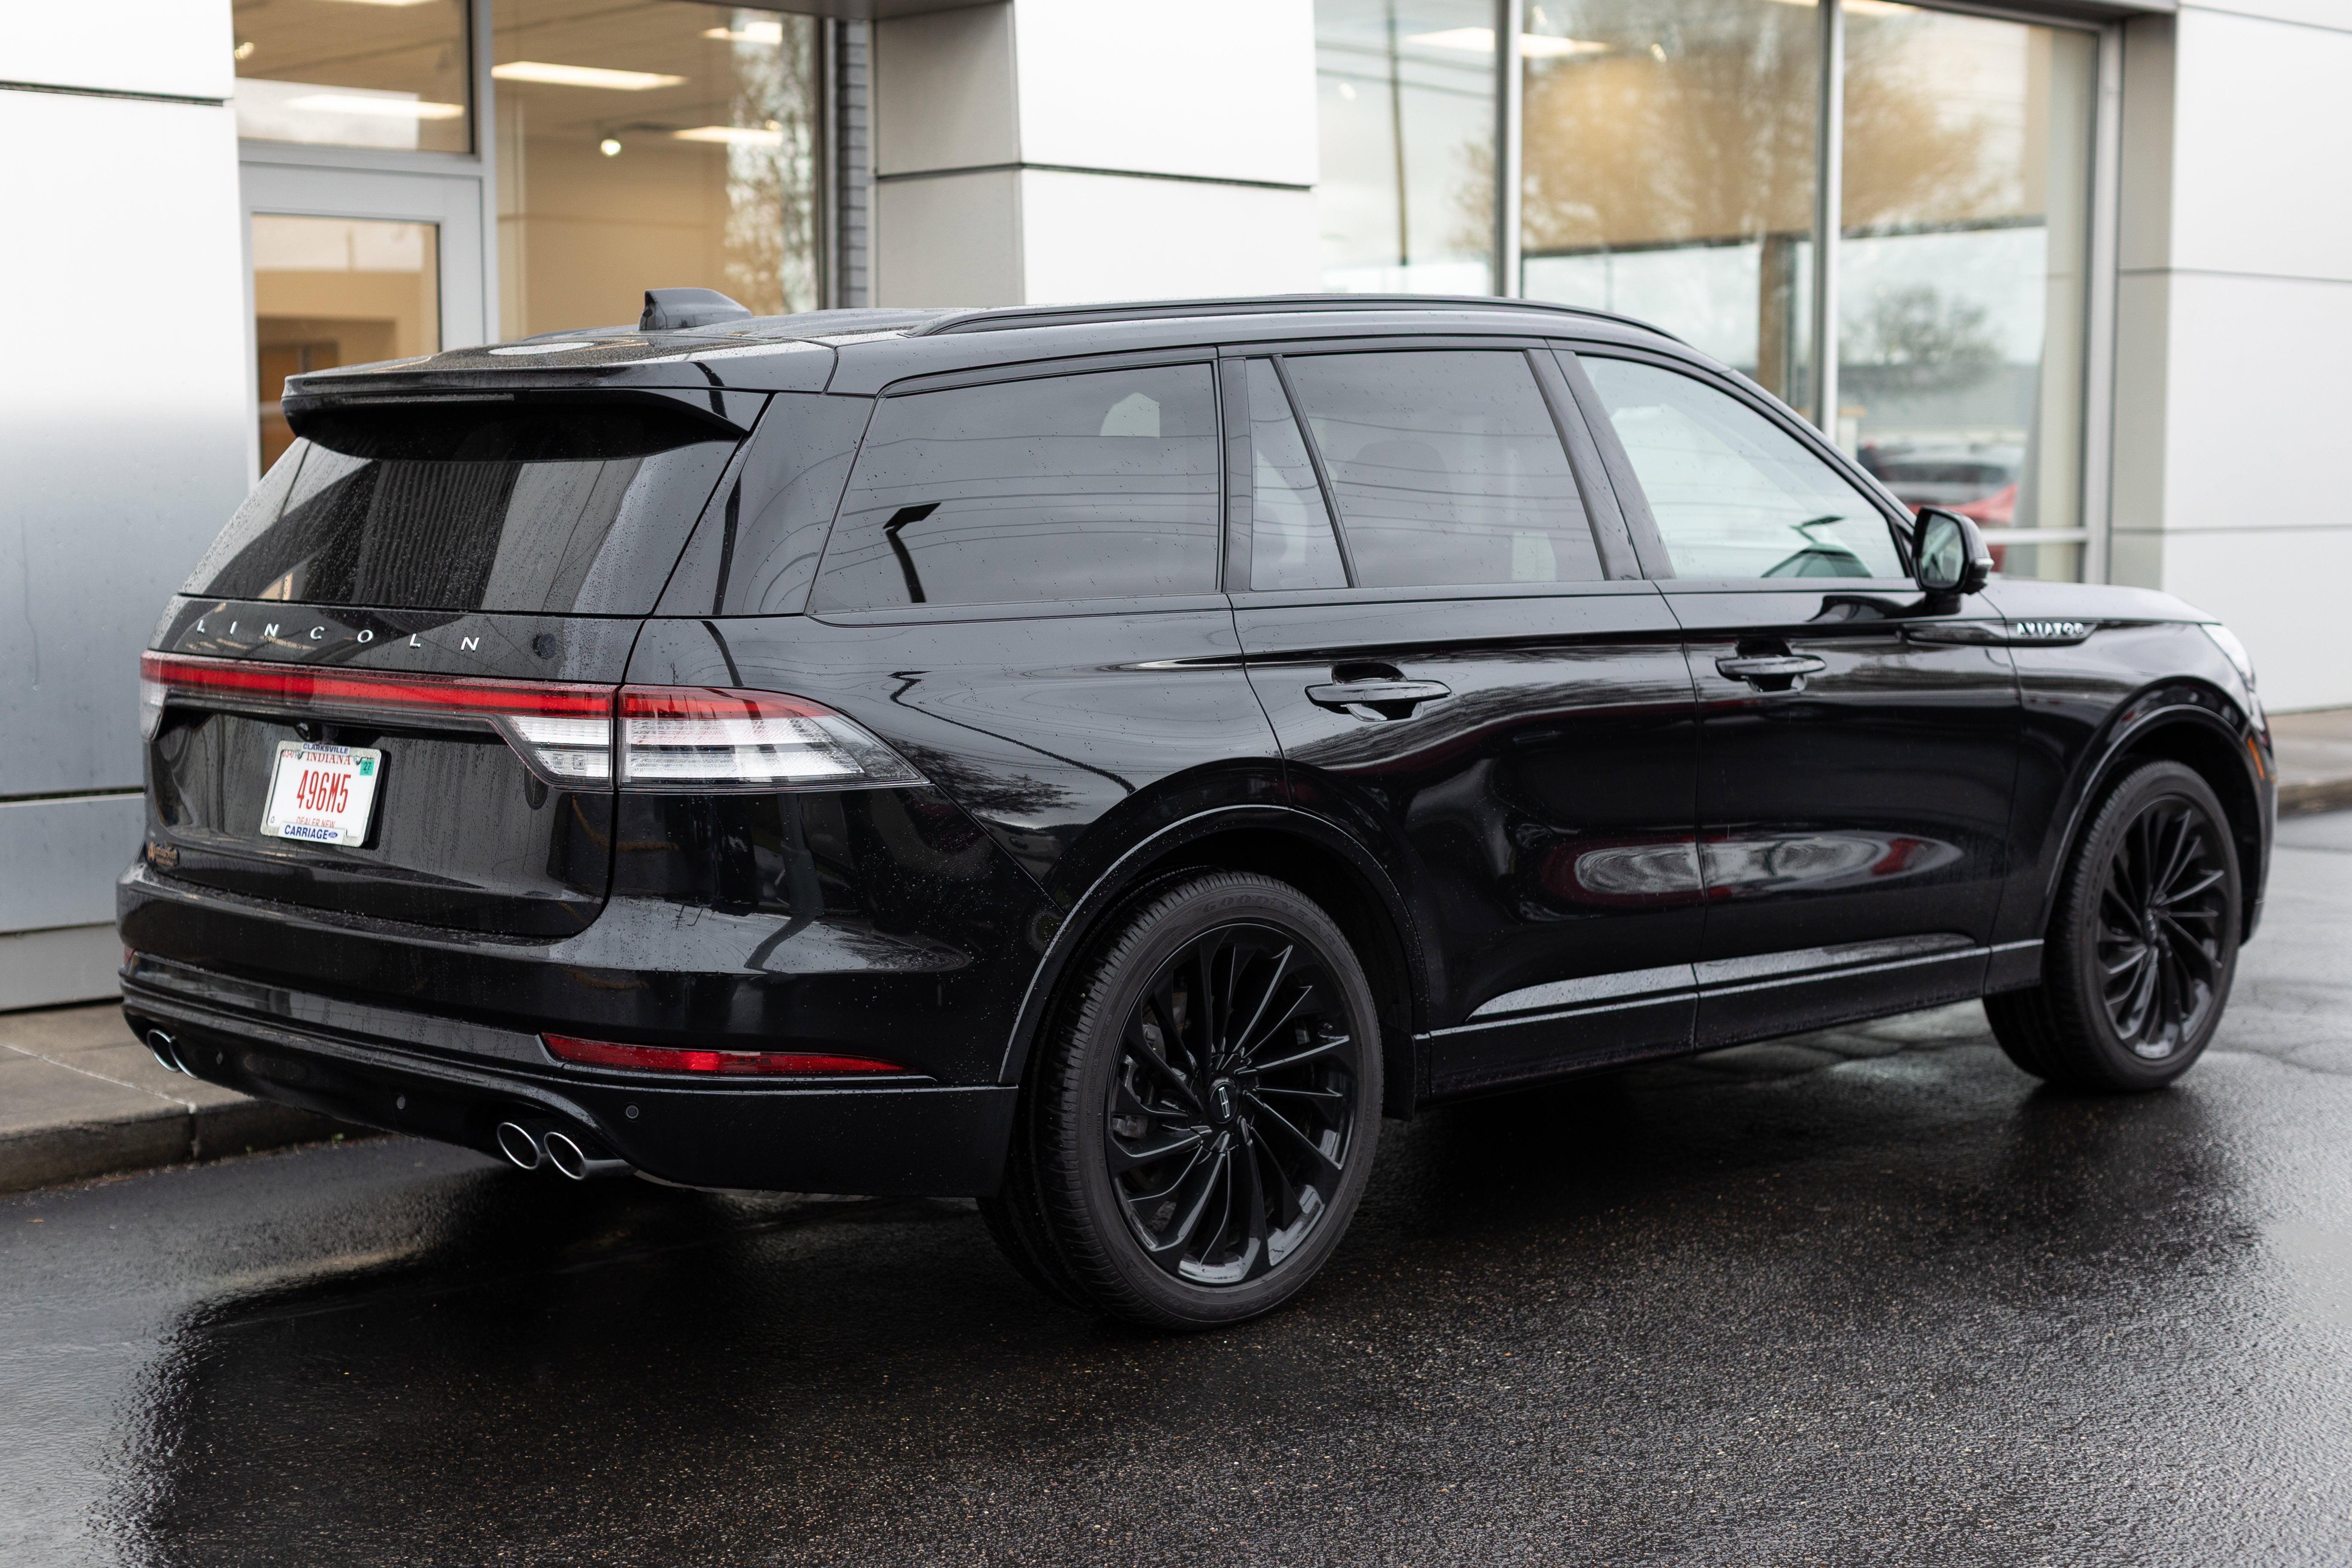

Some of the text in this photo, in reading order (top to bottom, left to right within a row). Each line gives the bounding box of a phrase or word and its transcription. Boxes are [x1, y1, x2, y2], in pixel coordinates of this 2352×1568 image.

[196, 619, 479, 651] LINCOLN
[303, 743, 349, 754] CLARKSVILLE
[306, 752, 351, 765] INDIANA
[363, 762, 371, 771] 27
[297, 770, 351, 813] 496M5
[296, 816, 335, 828] DEALER NEW
[285, 825, 329, 840] CARRIAGE
